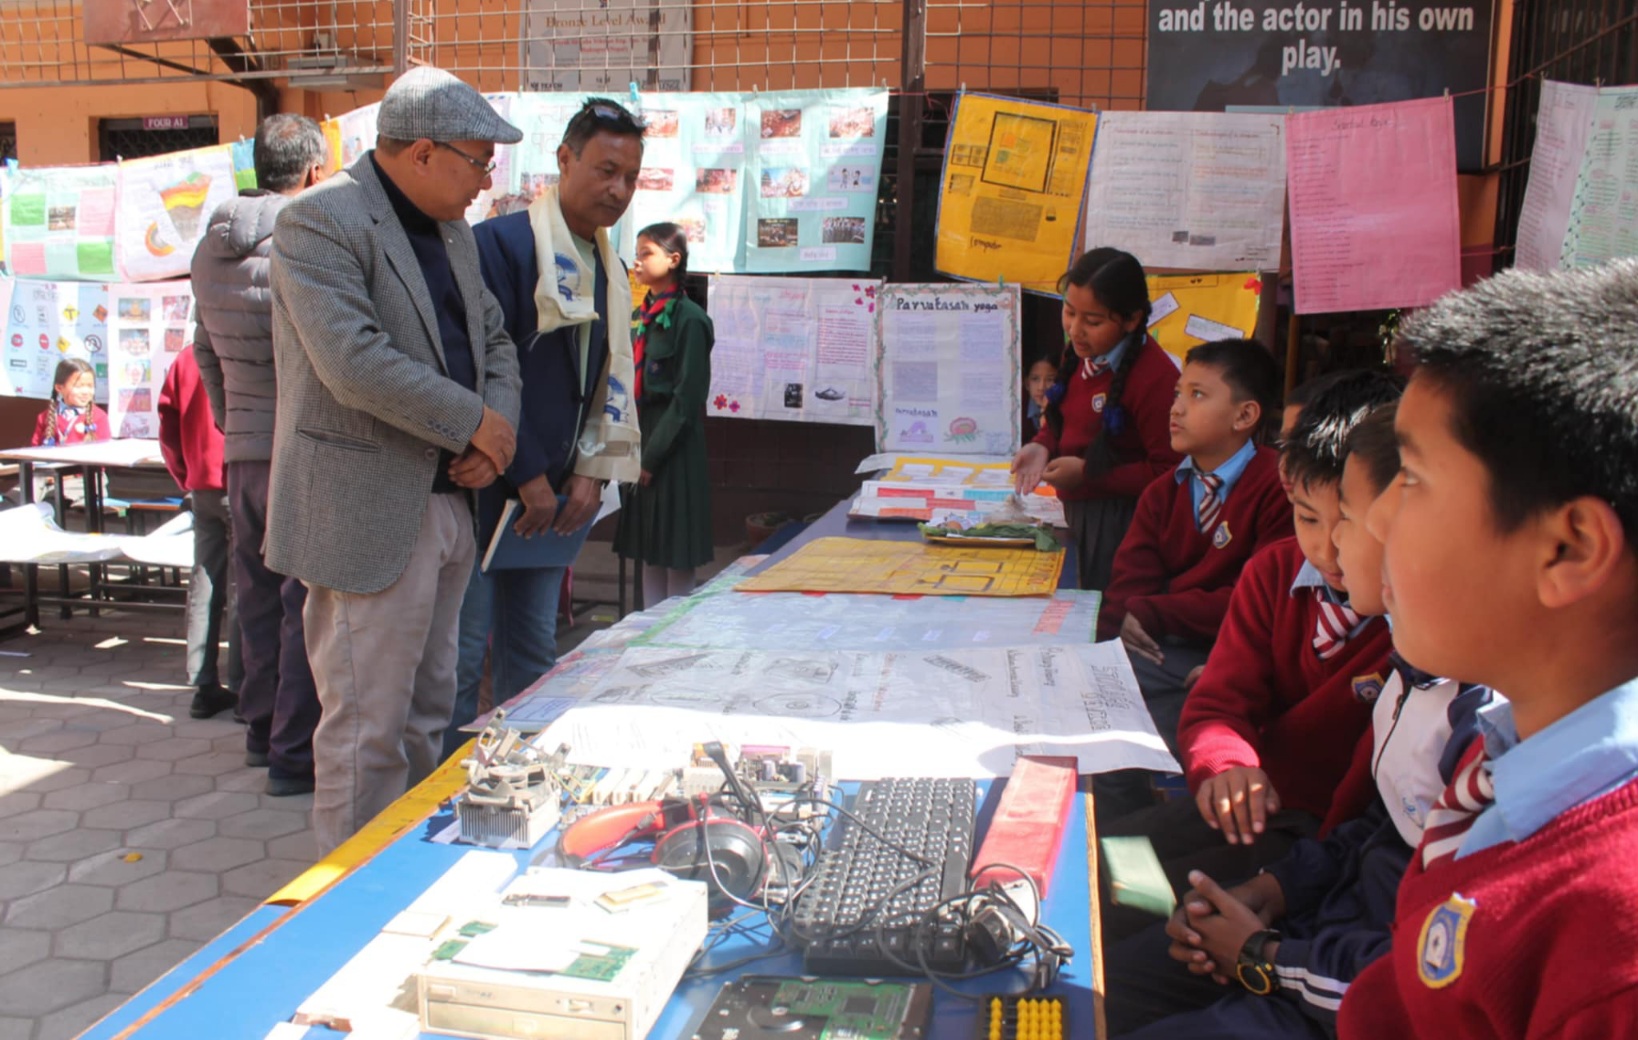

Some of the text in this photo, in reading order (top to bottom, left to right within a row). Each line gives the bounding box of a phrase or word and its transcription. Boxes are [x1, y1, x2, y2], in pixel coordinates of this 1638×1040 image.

[1158, 1, 1474, 31] and the actor in his own
[1281, 39, 1341, 76] play.
[148, 118, 172, 128] FOUR
[973, 302, 999, 313] yoga
